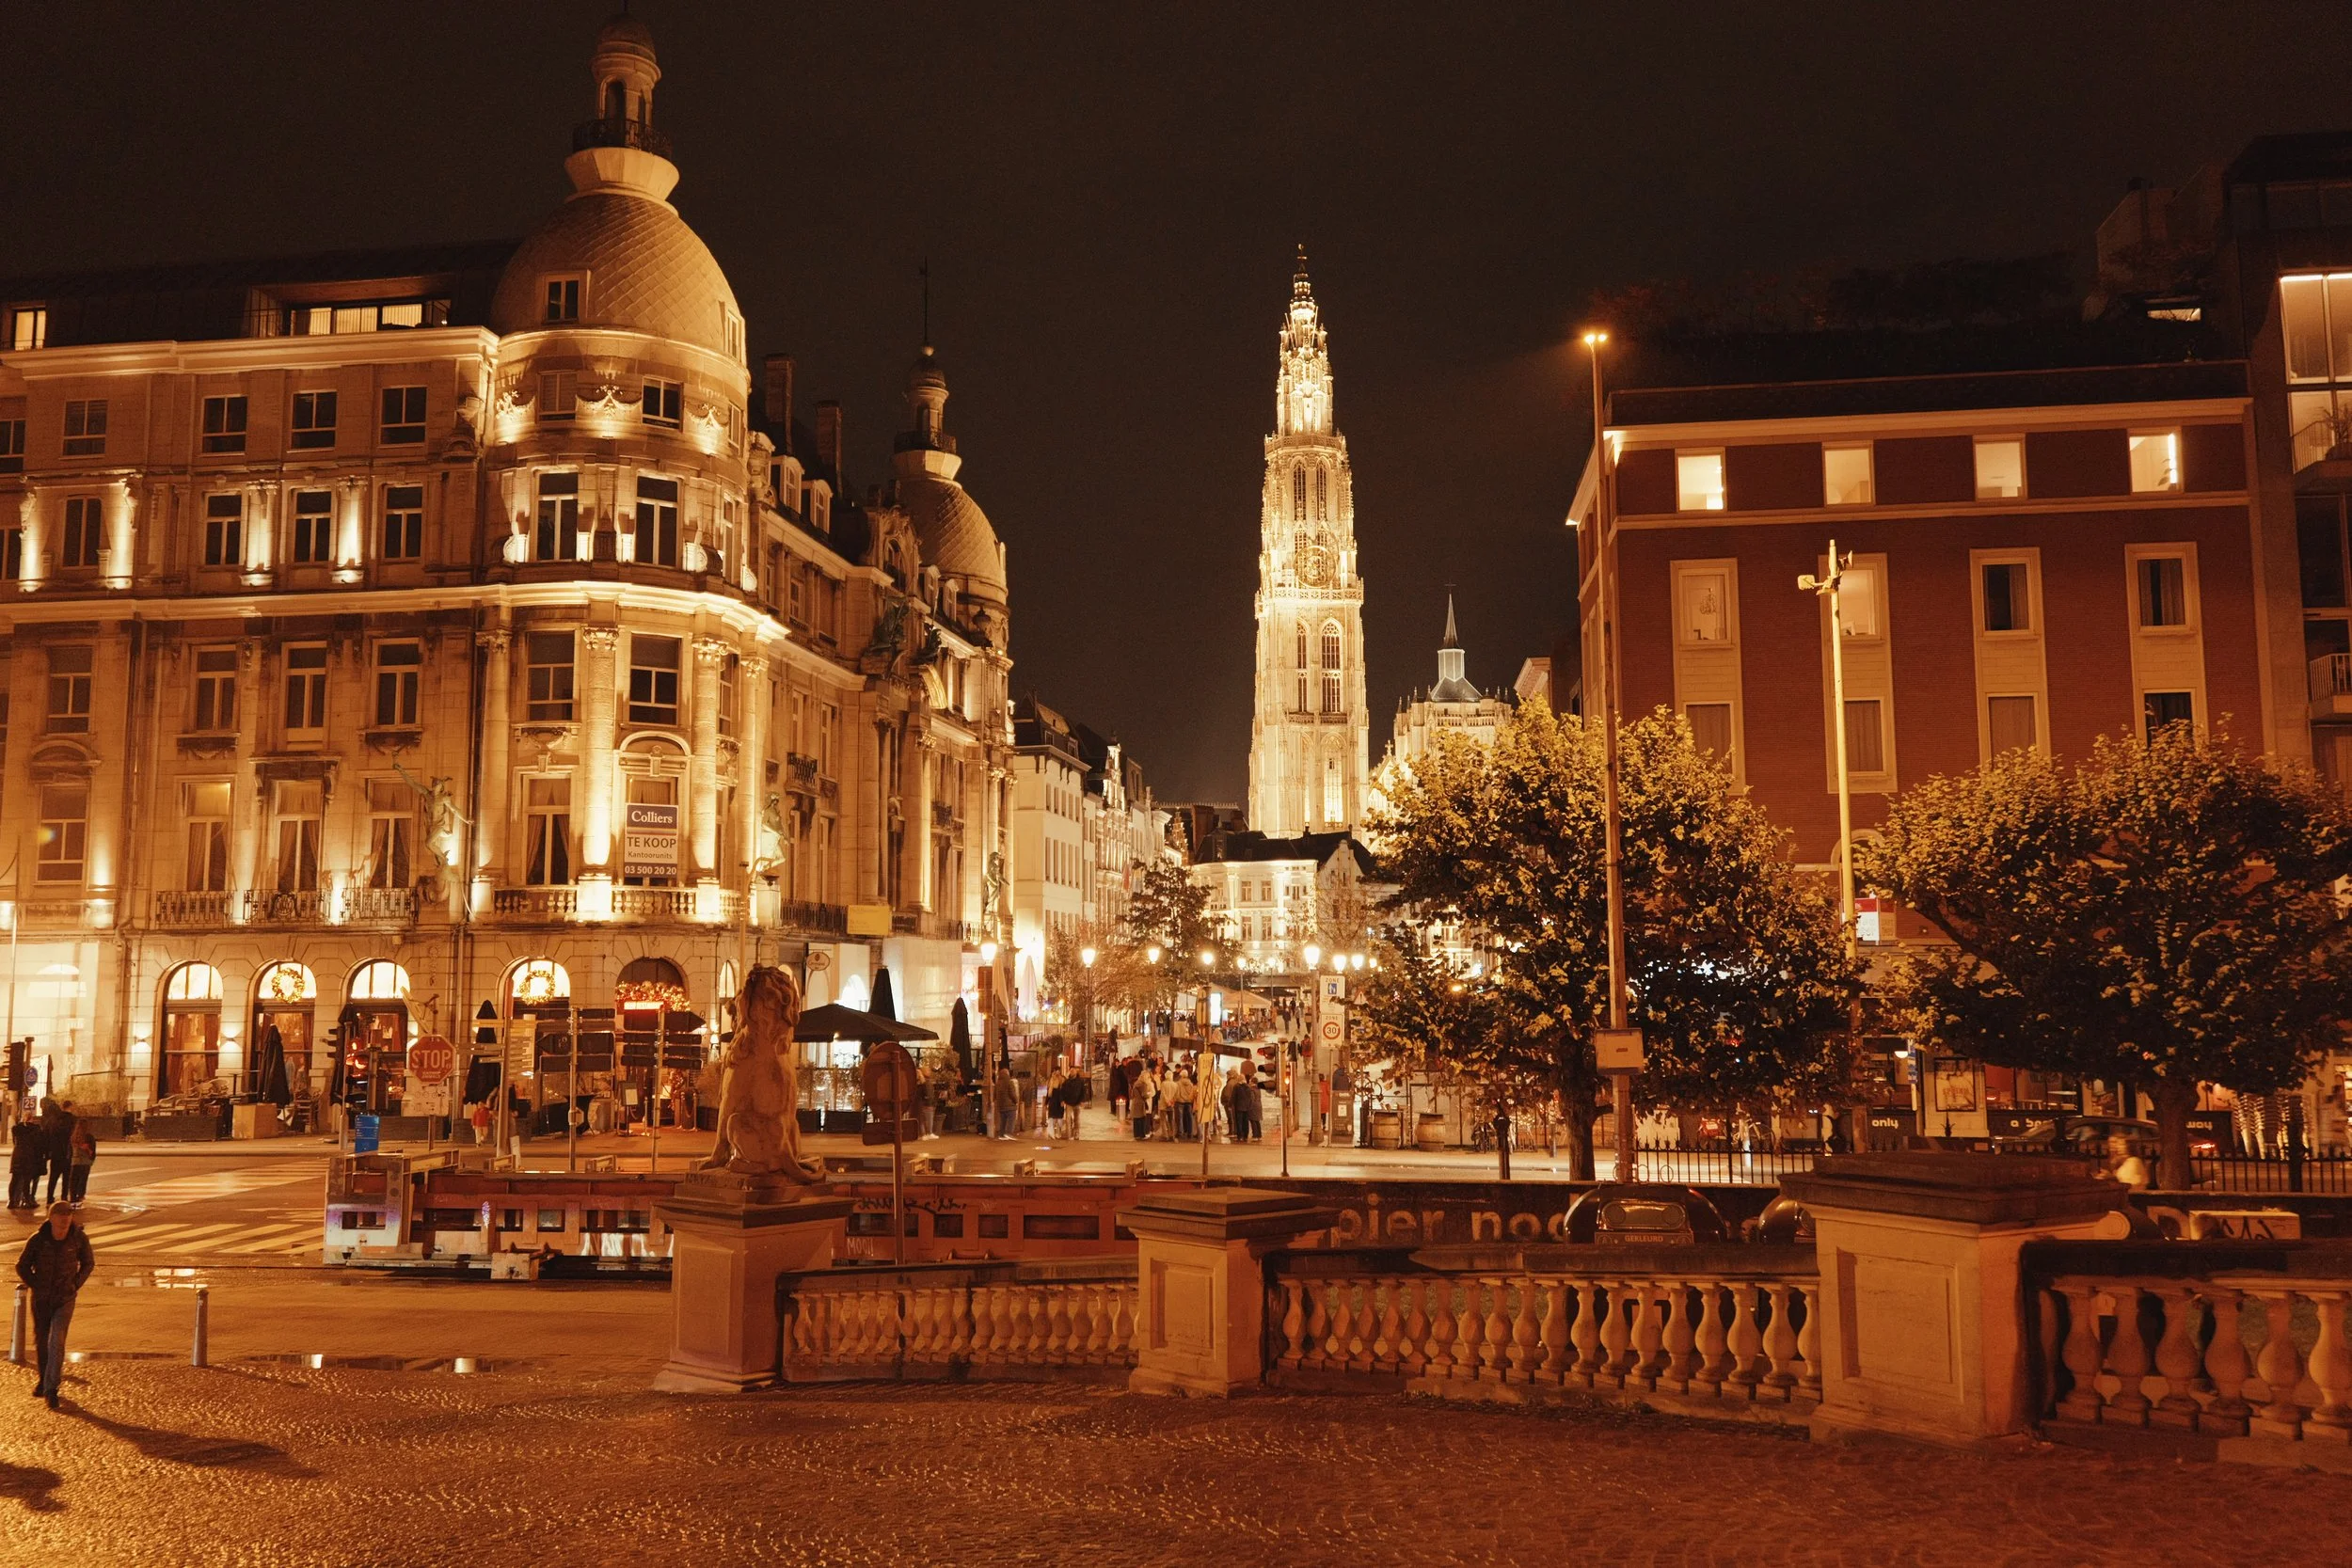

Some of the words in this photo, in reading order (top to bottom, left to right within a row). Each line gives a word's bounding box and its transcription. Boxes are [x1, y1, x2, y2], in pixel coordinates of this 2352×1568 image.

[631, 810, 673, 823] Colliers
[627, 836, 641, 847] TE
[644, 837, 676, 848] KOOP
[628, 850, 673, 860] Kantoorunits
[625, 865, 635, 874] 03
[637, 865, 653, 875] 500
[654, 866, 665, 875] 20
[666, 866, 677, 875] 20
[412, 1049, 452, 1069] STOP
[24, 1099, 35, 1109] 25
[1871, 1117, 1899, 1130] only
